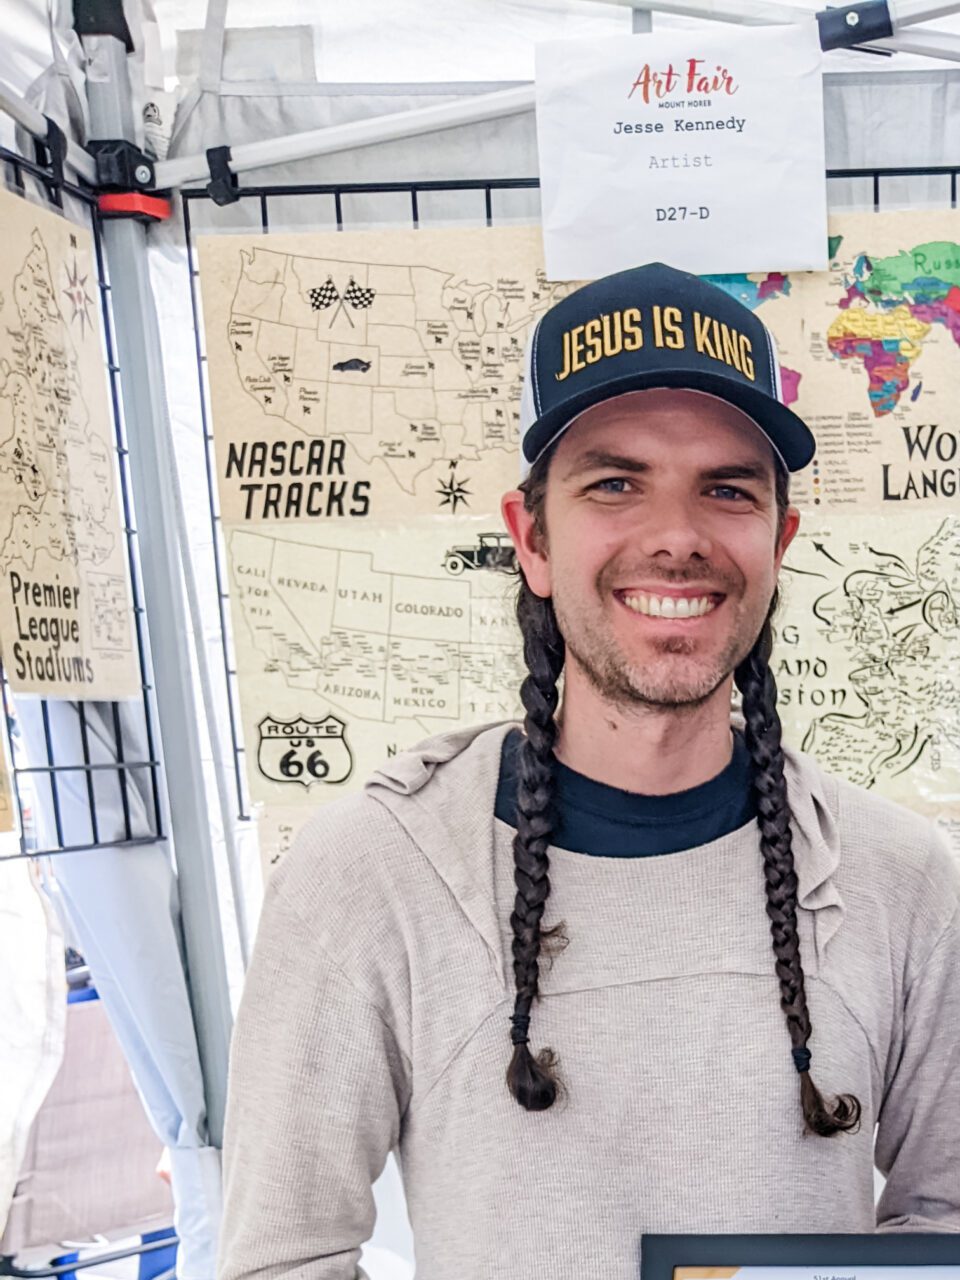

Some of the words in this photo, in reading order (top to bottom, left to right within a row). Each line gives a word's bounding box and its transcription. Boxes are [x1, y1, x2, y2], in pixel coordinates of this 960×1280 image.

[628, 63, 681, 104] Art
[686, 58, 739, 95] Fair
[658, 101, 685, 109] MOUNT
[687, 99, 712, 108] HOREB
[613, 121, 664, 135] Jesse
[675, 117, 747, 133] Kennedy
[648, 154, 713, 169] Artist
[656, 207, 710, 221] D27-D
[555, 308, 643, 381] JESUS
[652, 305, 685, 350] IS
[694, 312, 756, 382] KING
[225, 439, 347, 479] NASCAR
[240, 480, 371, 520] TRACKS
[237, 565, 267, 579] CALI
[9, 570, 80, 612] Premier
[247, 586, 270, 598] FOR
[277, 576, 329, 594] NEVADA
[338, 588, 383, 603] UTAH
[395, 603, 464, 618] COLORADO
[15, 606, 80, 648] League
[480, 616, 518, 627] KANS
[13, 640, 94, 685] Stadiums
[323, 683, 381, 701] ARIZONA
[411, 687, 434, 695] NEW
[778, 683, 848, 708] sion
[393, 697, 446, 708] MEXICO
[470, 702, 523, 713] TEXA
[267, 724, 338, 736] ROUTE
[289, 739, 316, 748] US
[279, 749, 330, 779] 66
